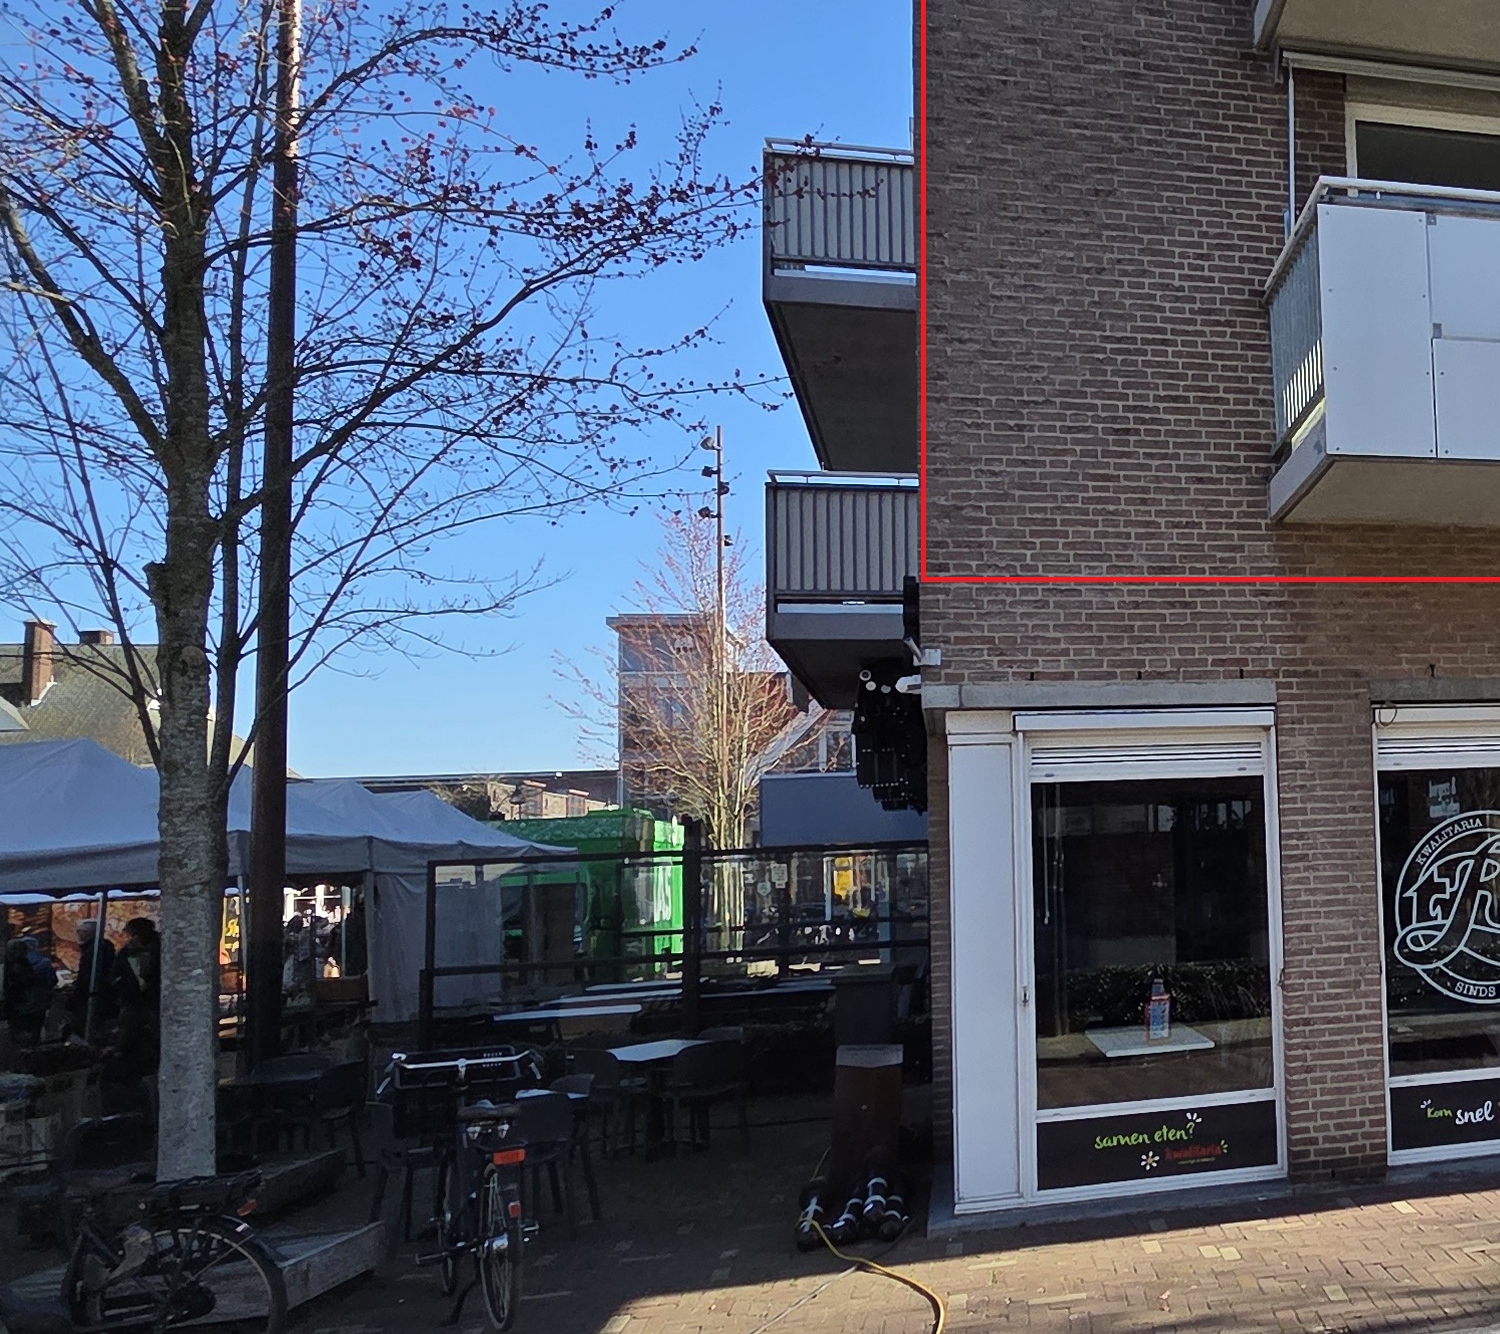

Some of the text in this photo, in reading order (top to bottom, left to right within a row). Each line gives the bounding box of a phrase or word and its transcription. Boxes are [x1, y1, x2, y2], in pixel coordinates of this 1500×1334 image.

[1415, 817, 1483, 866] KWALITARIA
[1455, 981, 1496, 997] SINDS
[1455, 1100, 1495, 1125] snel
[1094, 1121, 1195, 1149] samen eten?
